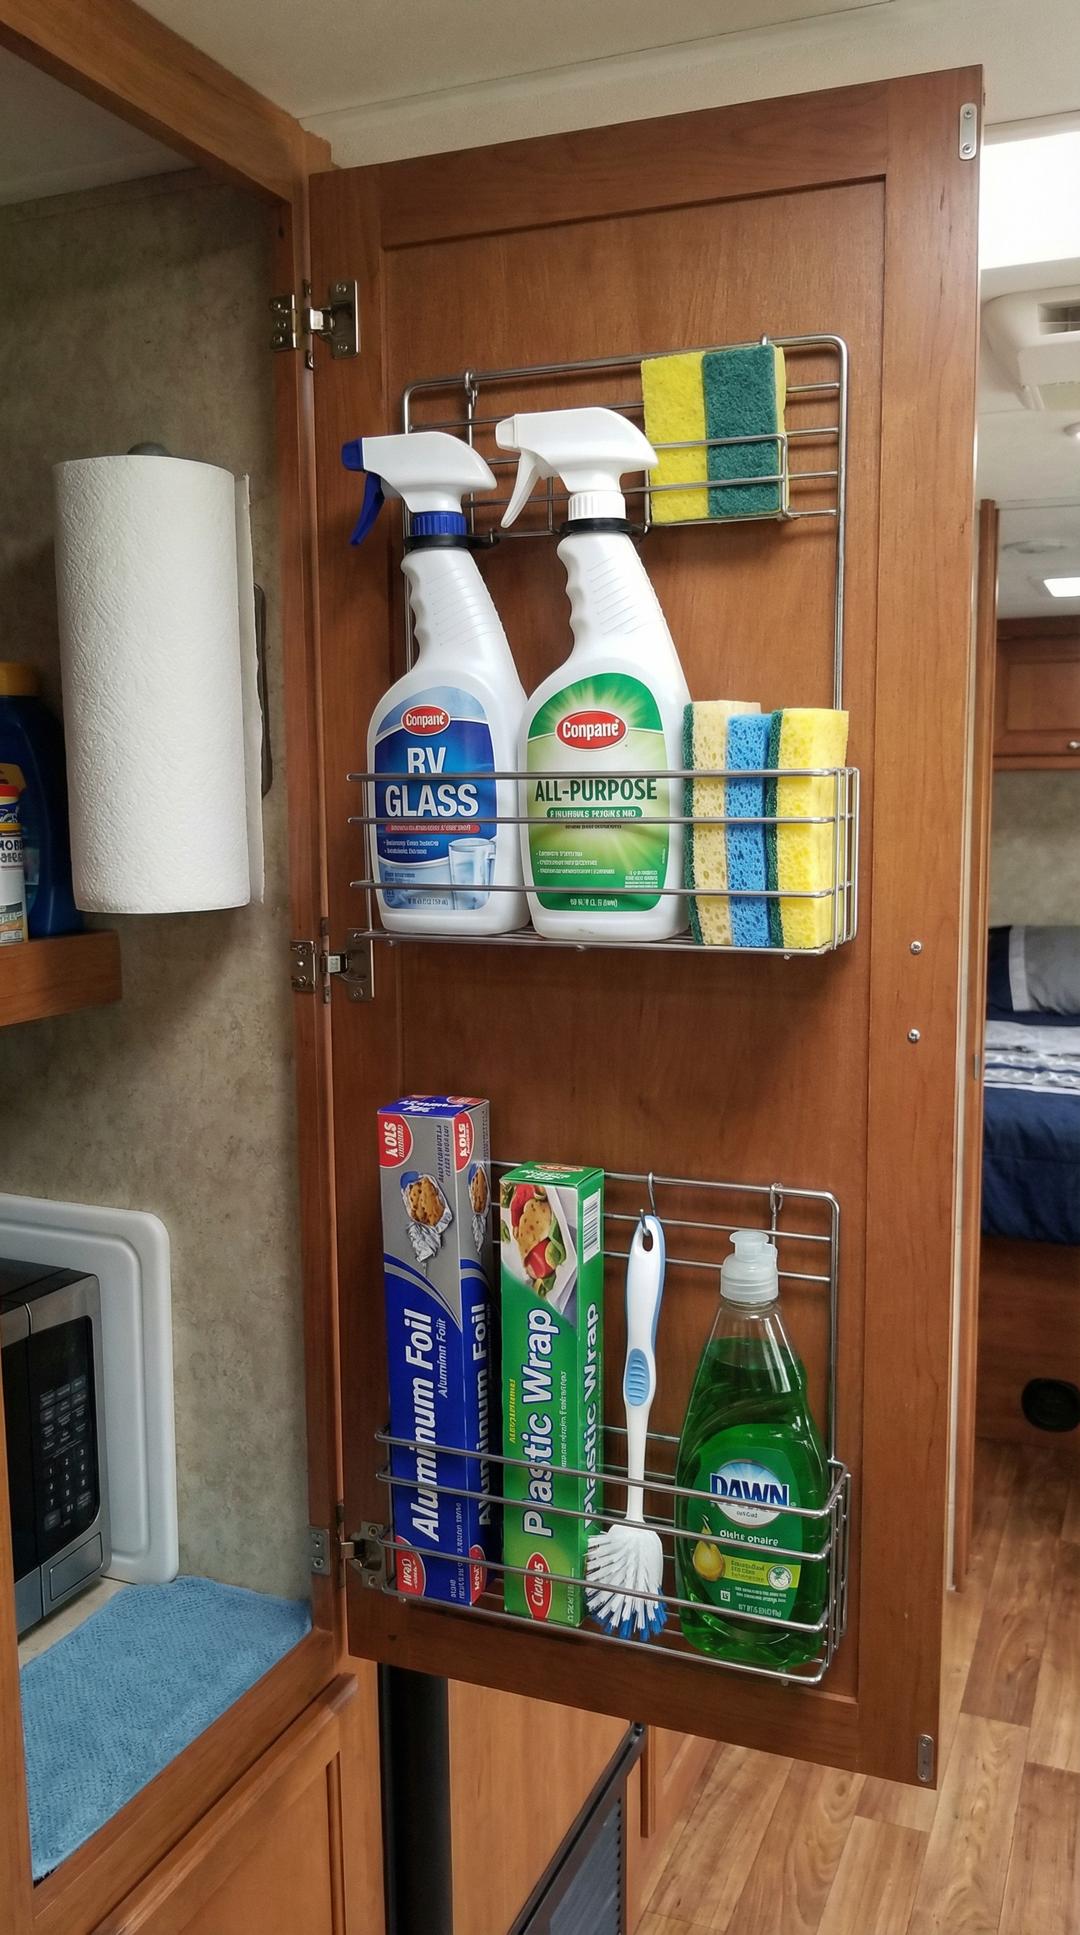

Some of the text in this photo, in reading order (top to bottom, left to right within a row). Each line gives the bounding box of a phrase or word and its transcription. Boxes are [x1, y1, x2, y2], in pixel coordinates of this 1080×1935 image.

[407, 747, 446, 774] RV
[385, 784, 479, 817] GLASS
[535, 778, 657, 802] ALL-PURPOSE
[405, 1309, 433, 1370] Foil
[471, 1303, 487, 1361] Foil
[521, 1308, 560, 1403] Wrap
[583, 1303, 599, 1401] Wrap
[411, 1377, 439, 1542] Aluminum
[710, 1473, 790, 1507] DAWN
